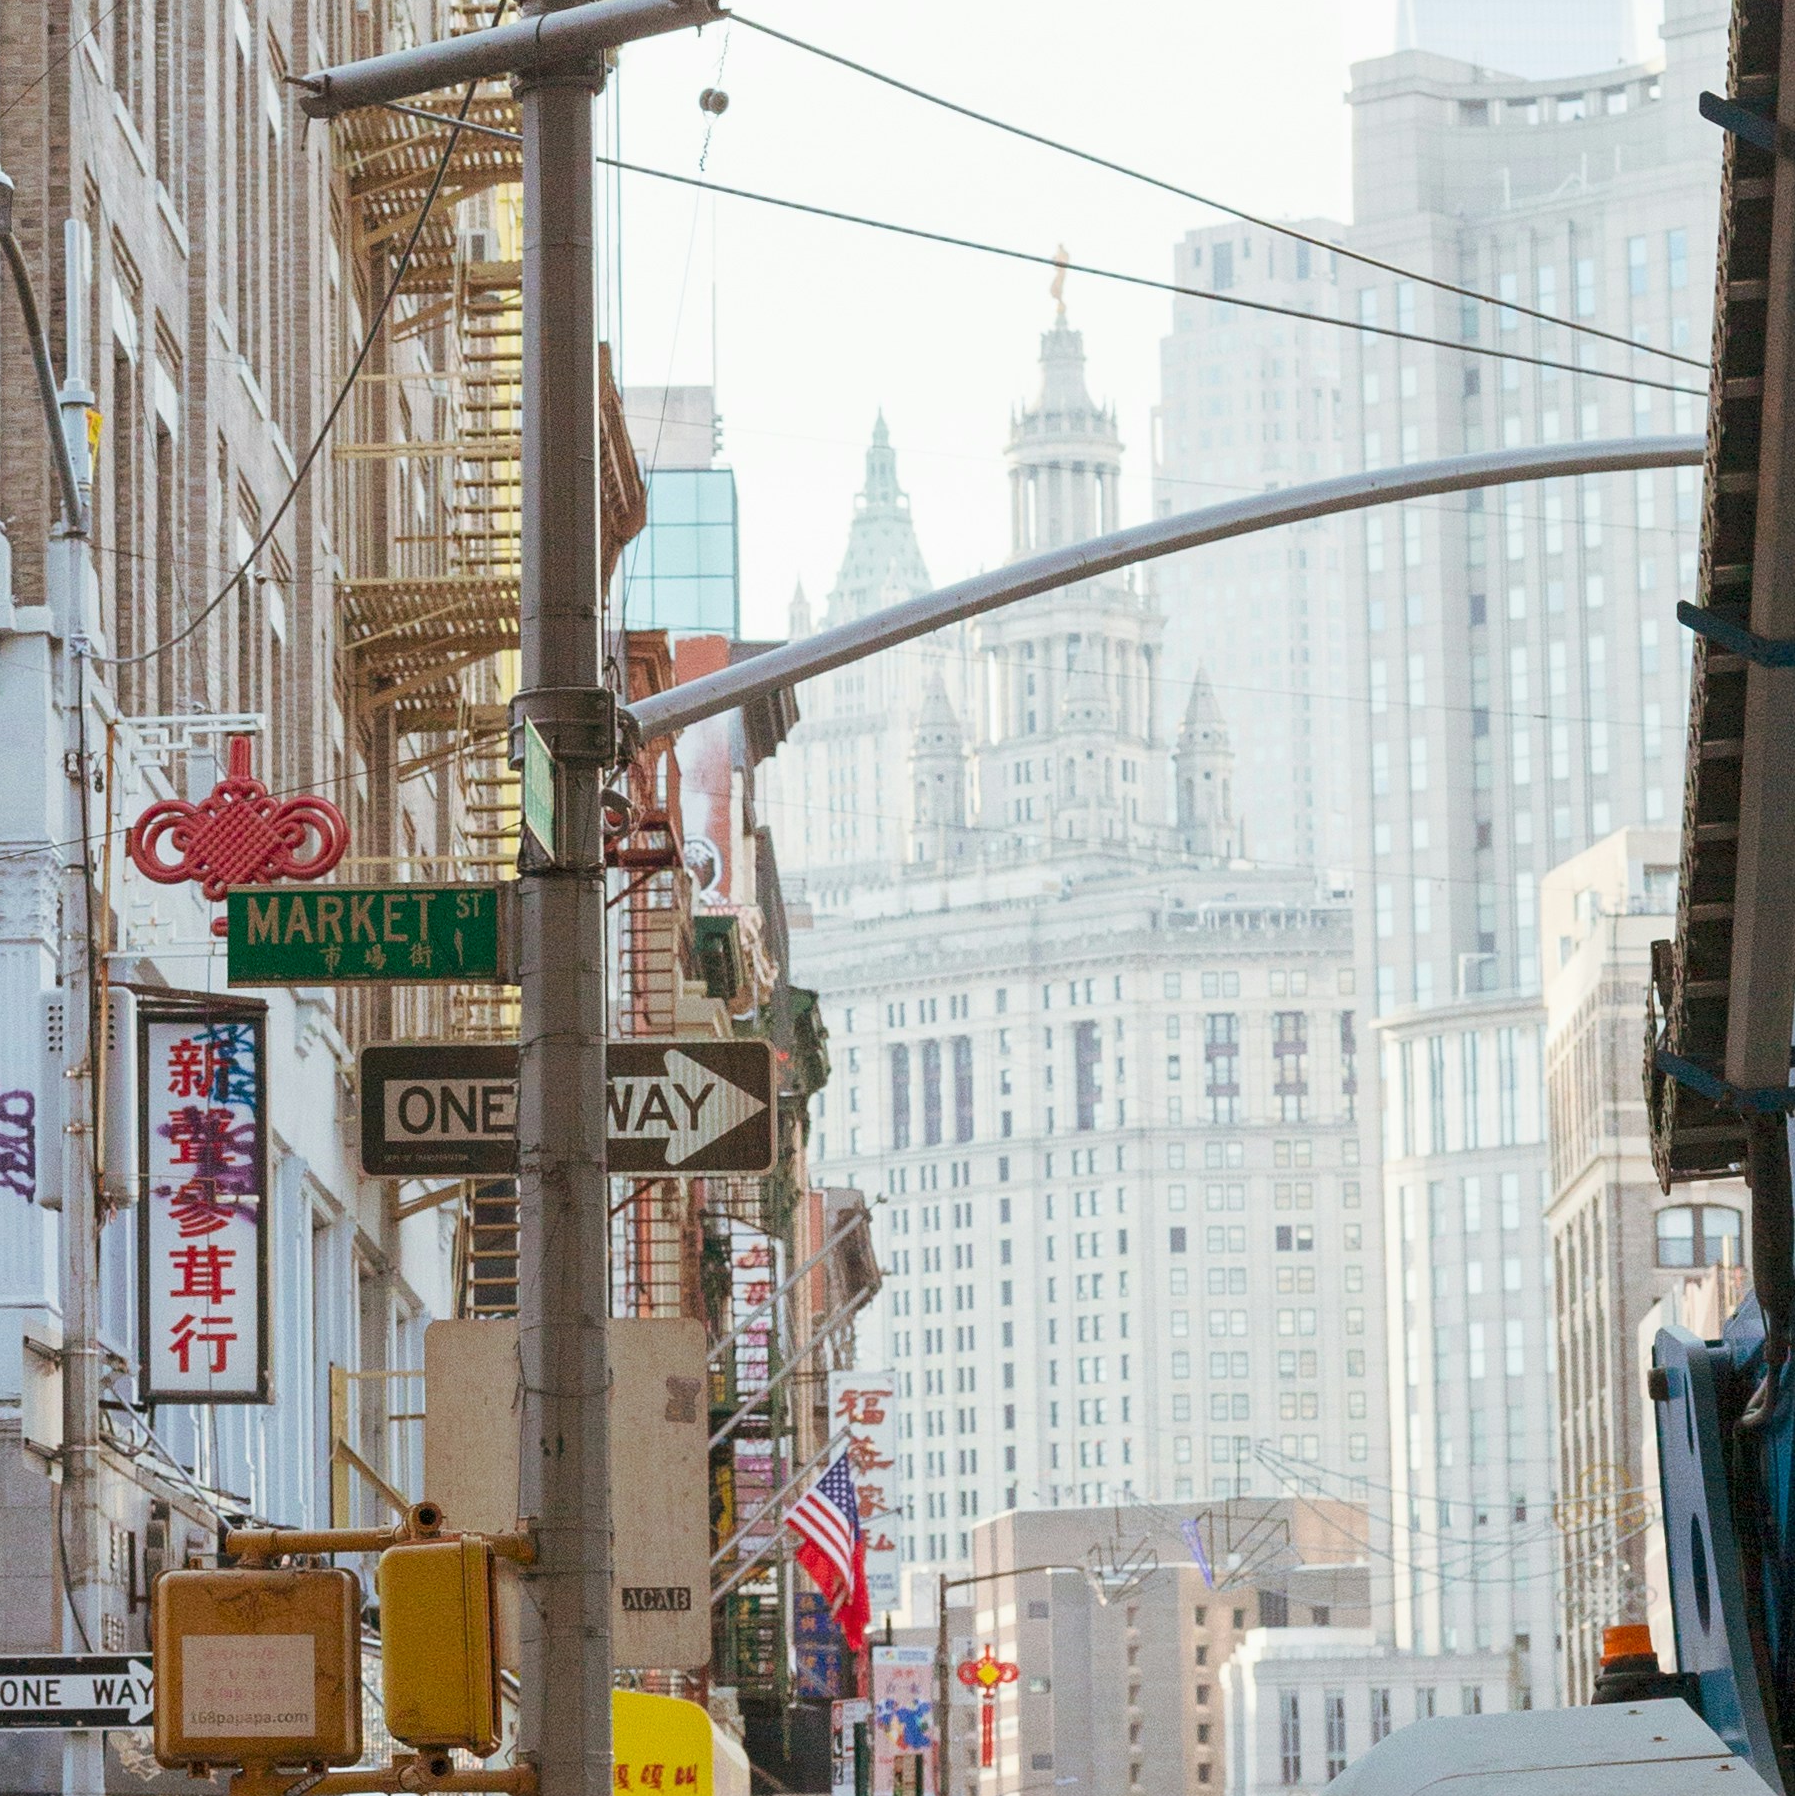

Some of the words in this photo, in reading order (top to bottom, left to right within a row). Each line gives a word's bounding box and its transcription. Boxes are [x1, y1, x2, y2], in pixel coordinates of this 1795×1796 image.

[246, 893, 436, 946] MARKET
[455, 891, 484, 919] ST
[320, 942, 432, 972] 市場街
[397, 1084, 516, 1135] ONE
[622, 1587, 690, 1610] ACAB
[0, 1679, 62, 1707] ONE
[92, 1678, 154, 1705] WAY
